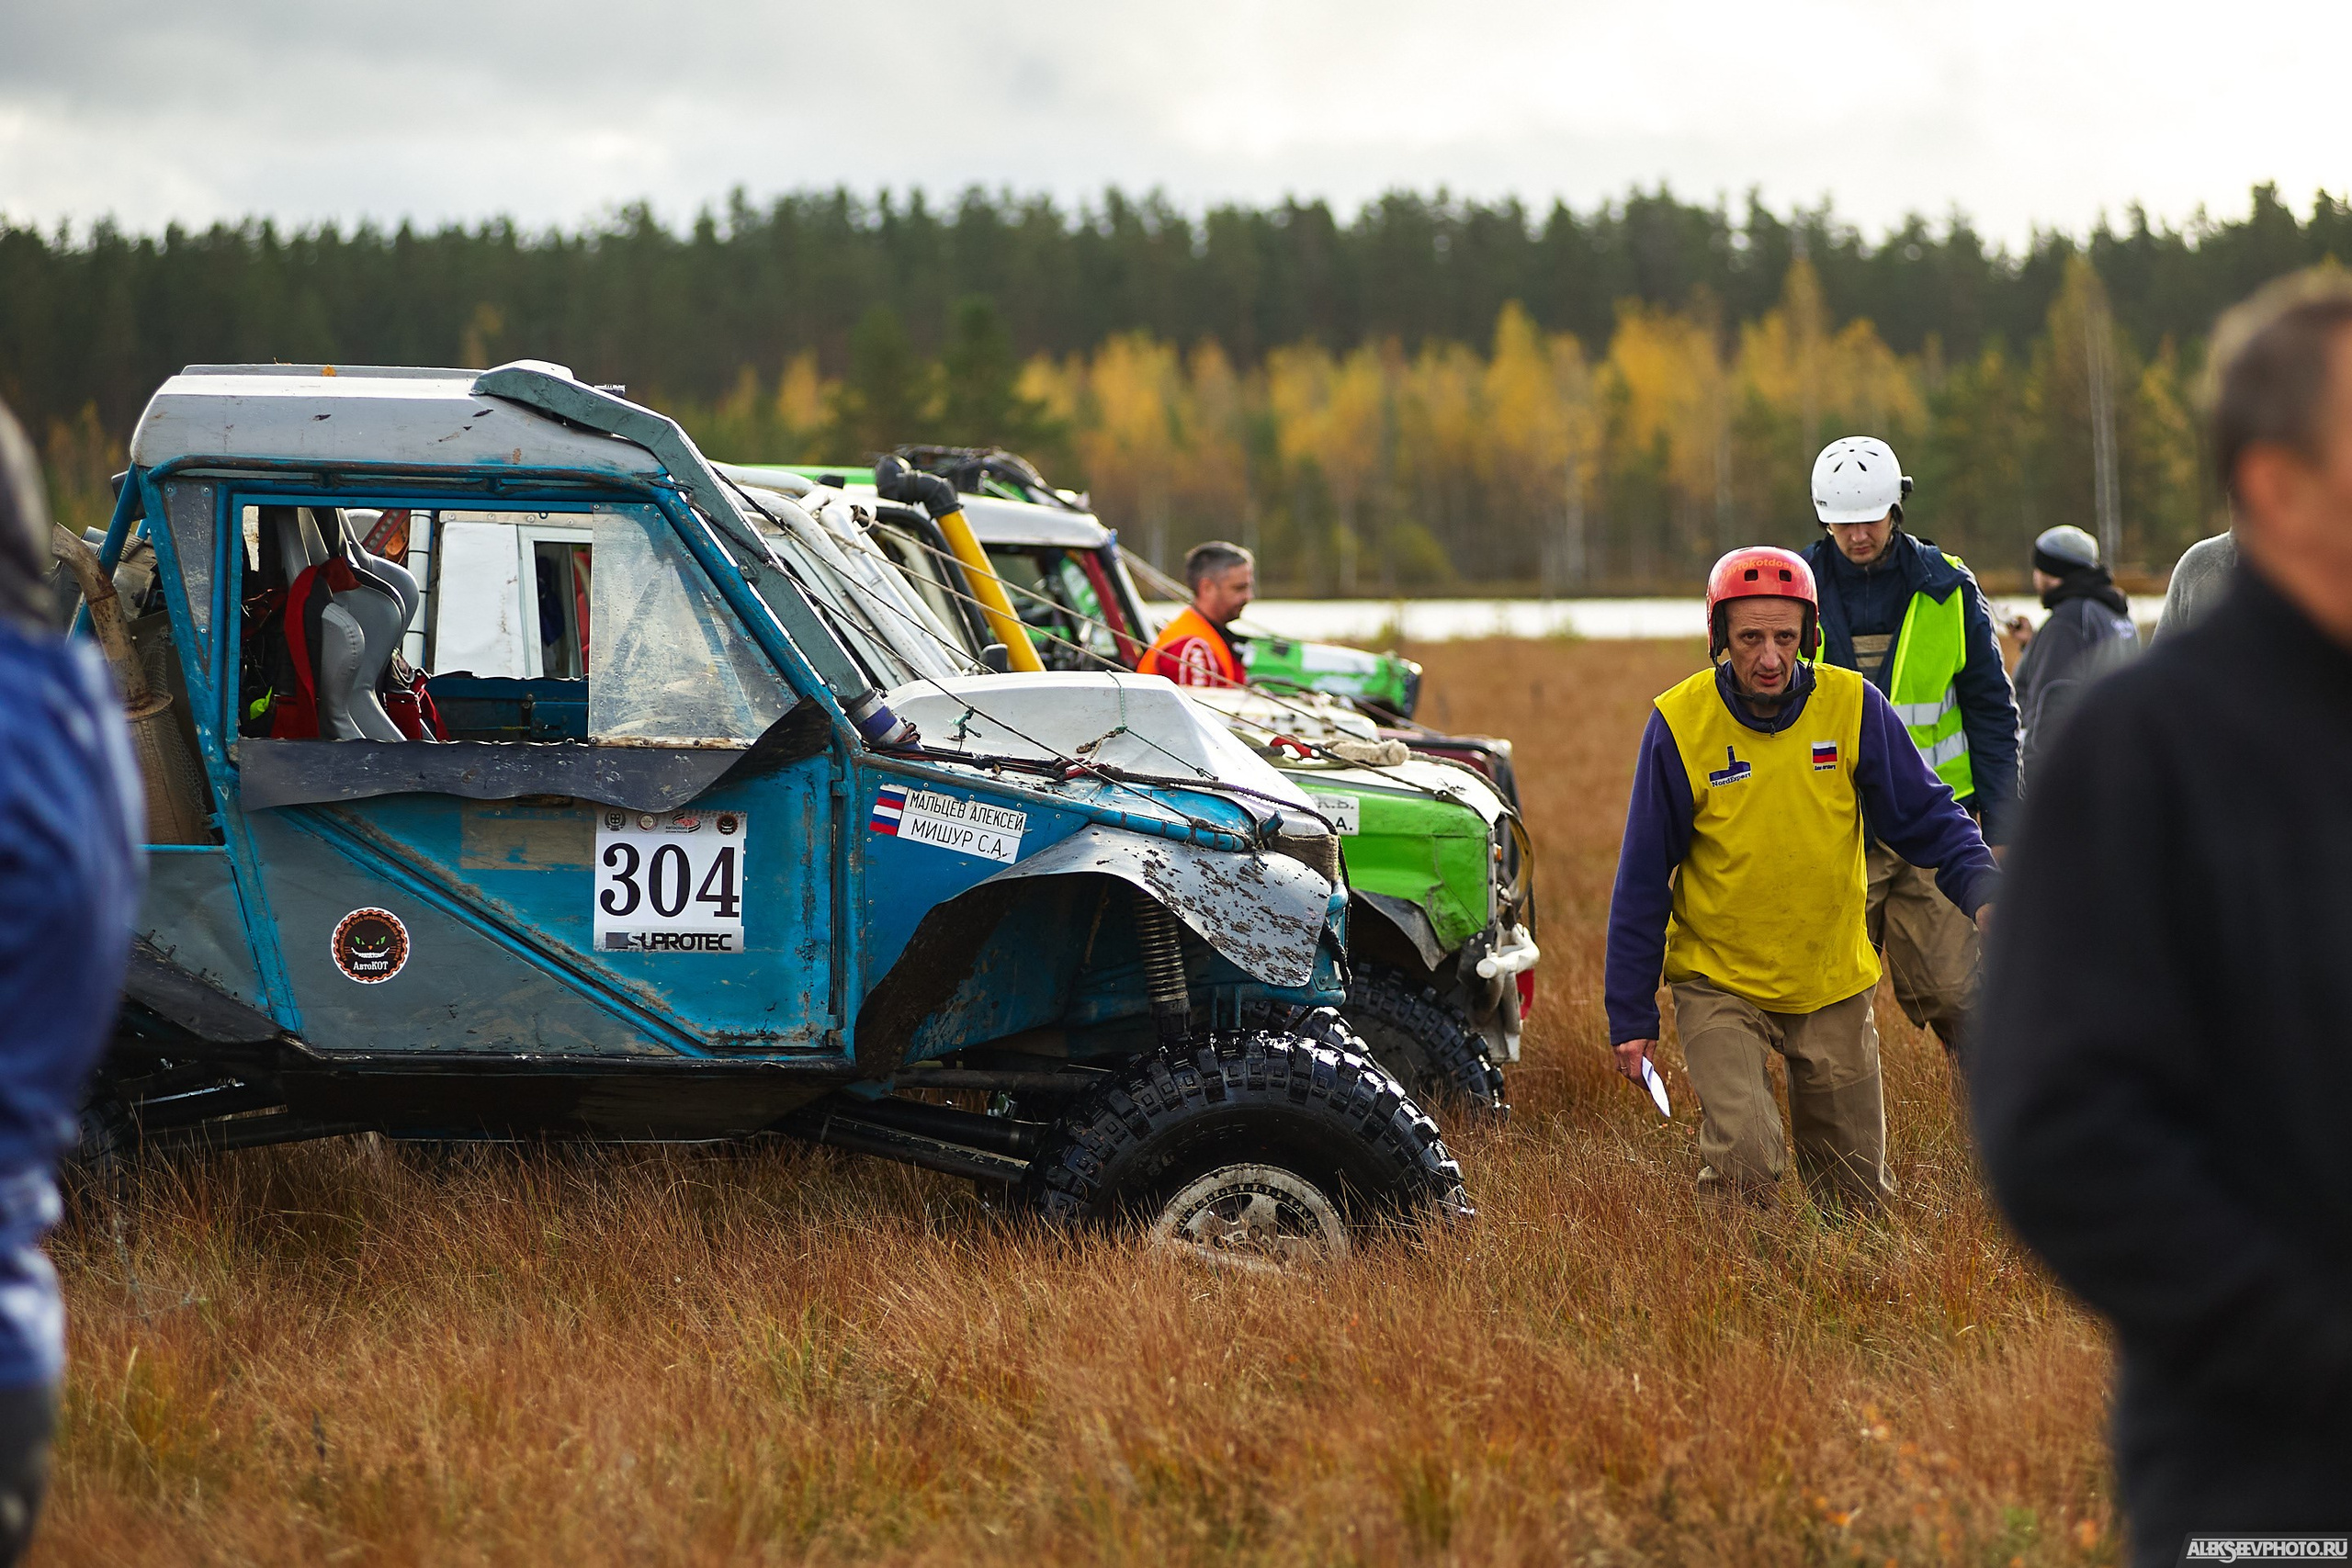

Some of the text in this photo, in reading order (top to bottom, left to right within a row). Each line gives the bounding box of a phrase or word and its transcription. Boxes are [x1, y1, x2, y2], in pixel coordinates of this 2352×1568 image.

[910, 792, 1024, 831] МАЛЬЦЕВ АЛЕКСЕЙ
[910, 818, 973, 847] МИШУР
[599, 842, 740, 918] 304
[628, 931, 732, 952] SUPROTEC
